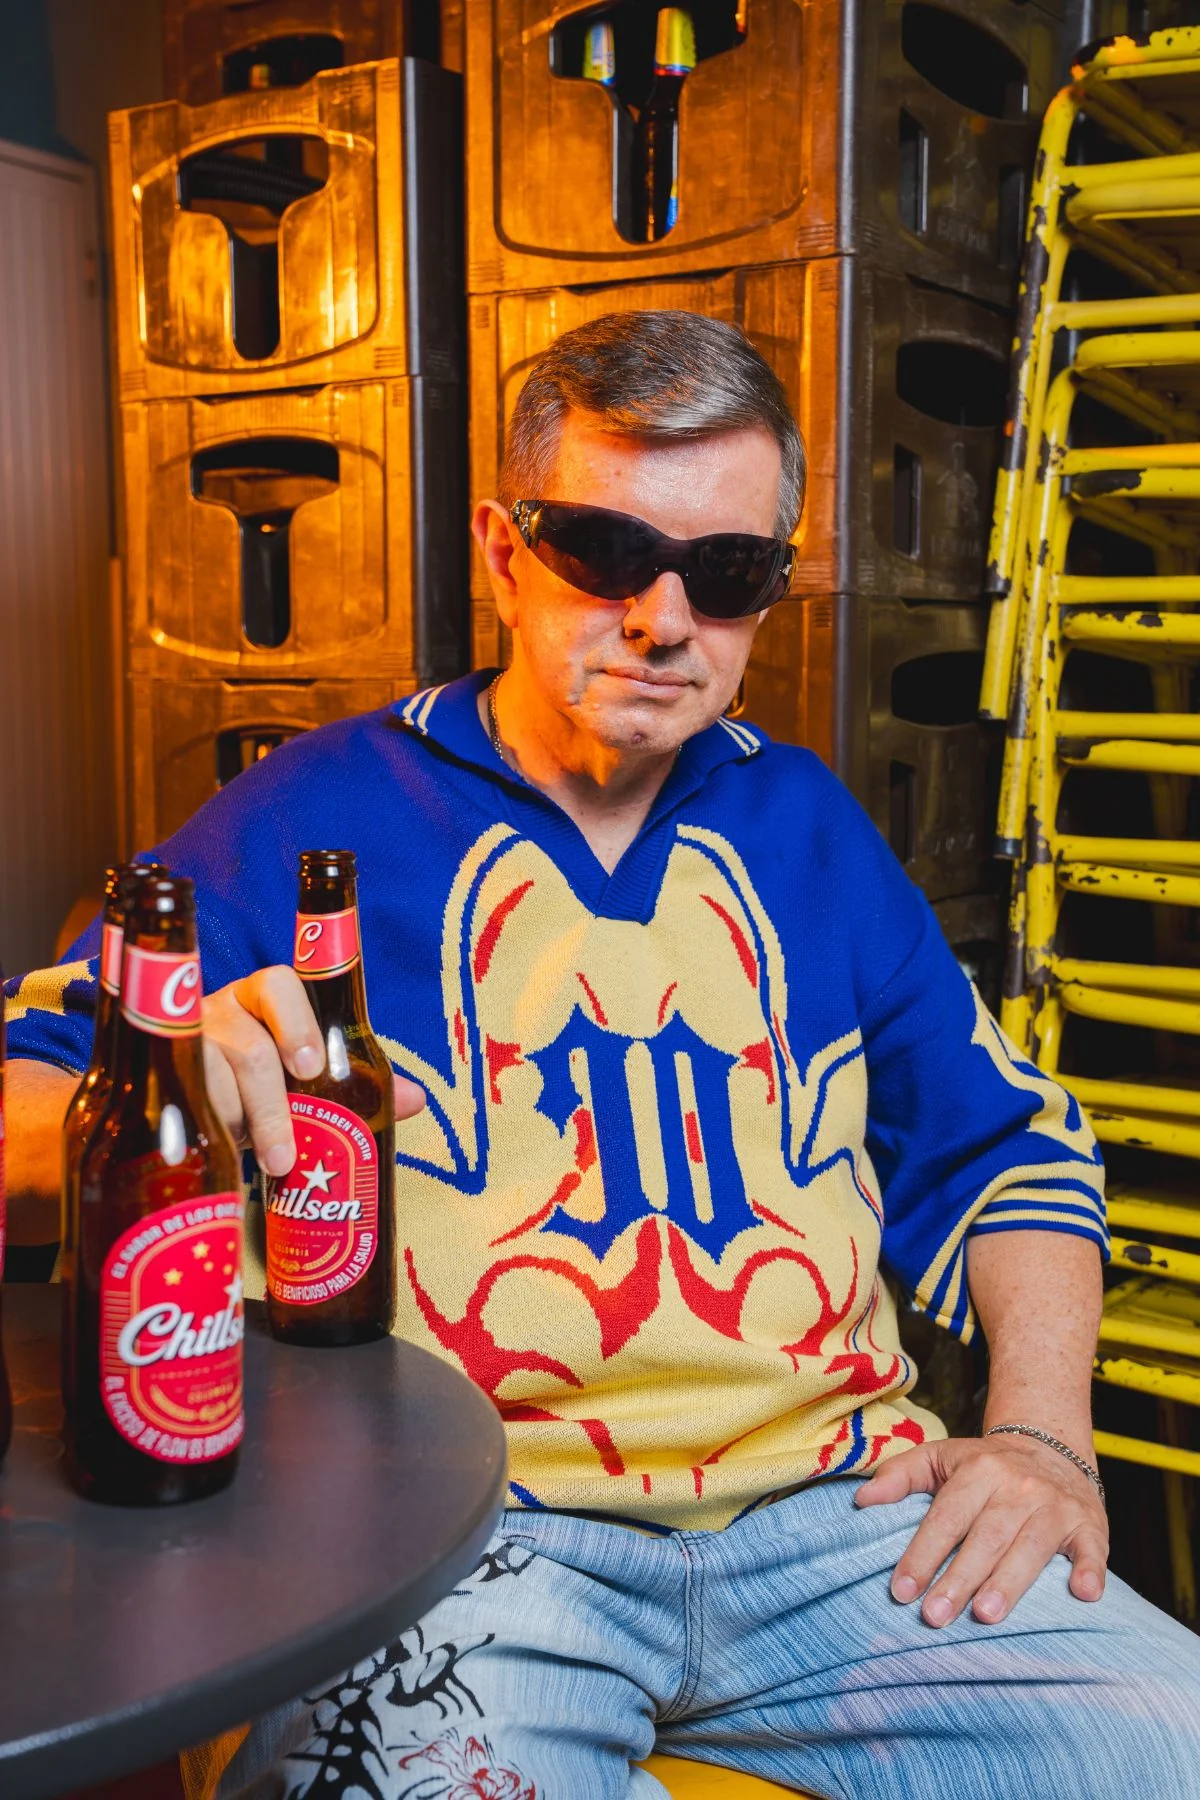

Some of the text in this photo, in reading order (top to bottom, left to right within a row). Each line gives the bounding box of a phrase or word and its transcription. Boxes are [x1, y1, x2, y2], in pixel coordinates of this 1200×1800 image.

[296, 921, 323, 962] C
[161, 961, 199, 1017] C
[291, 1102, 372, 1161] QUE SABEN VESTIR
[267, 1186, 362, 1222] hillsen
[353, 1232, 373, 1265] SALUD
[326, 1271, 353, 1294] PARA
[345, 1262, 363, 1278] LA
[274, 1280, 283, 1296] ES
